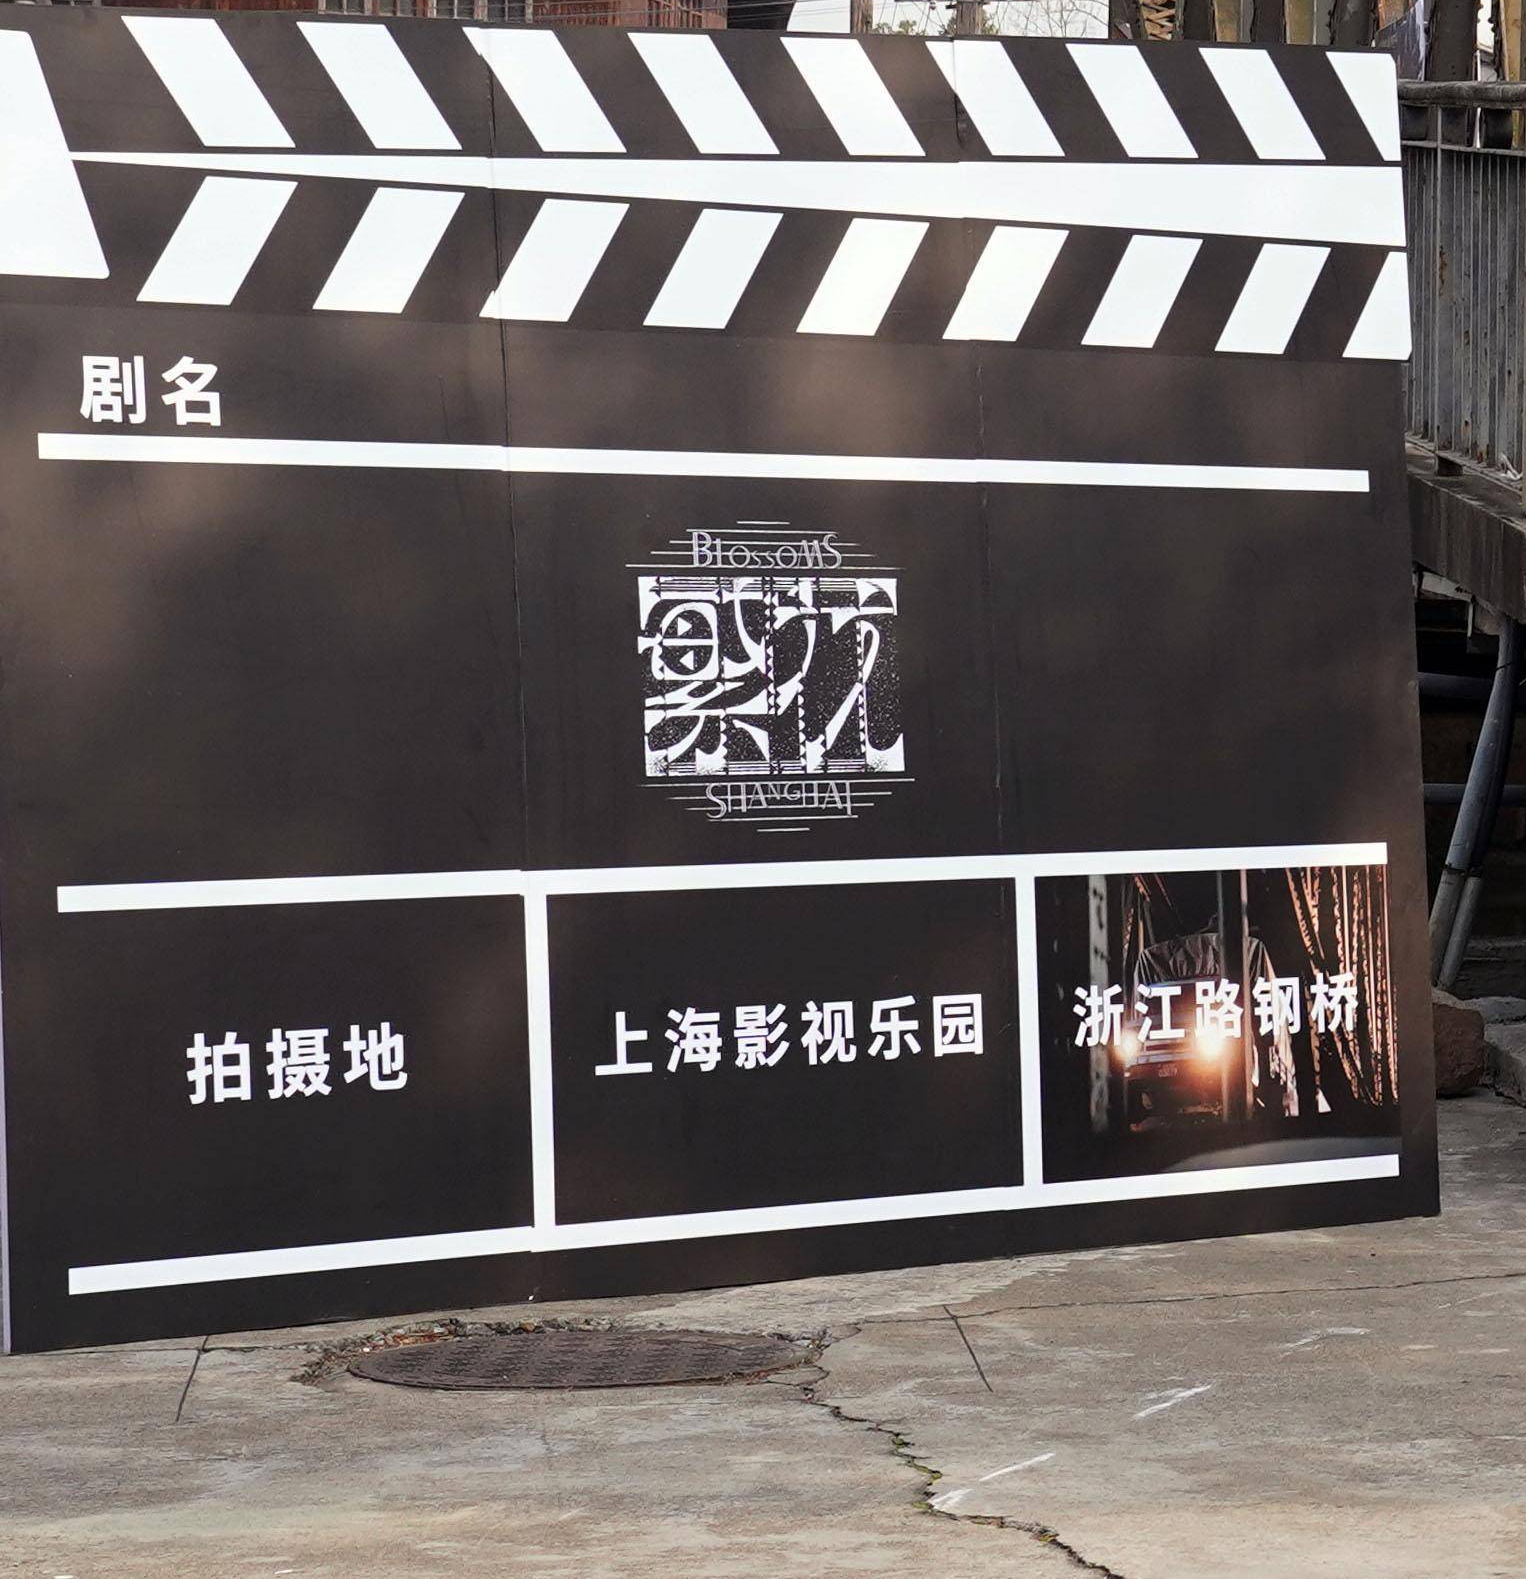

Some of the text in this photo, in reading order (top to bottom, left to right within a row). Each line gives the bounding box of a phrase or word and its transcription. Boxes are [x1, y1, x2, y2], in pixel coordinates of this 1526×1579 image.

[79, 355, 222, 427] 剧名
[637, 575, 906, 777] 繁花
[704, 781, 853, 819] SHANGHAI
[594, 992, 985, 1076] 上海影视乐园
[1072, 972, 1359, 1047] 浙江路钢桥
[185, 1021, 409, 1105] 拍摄地
